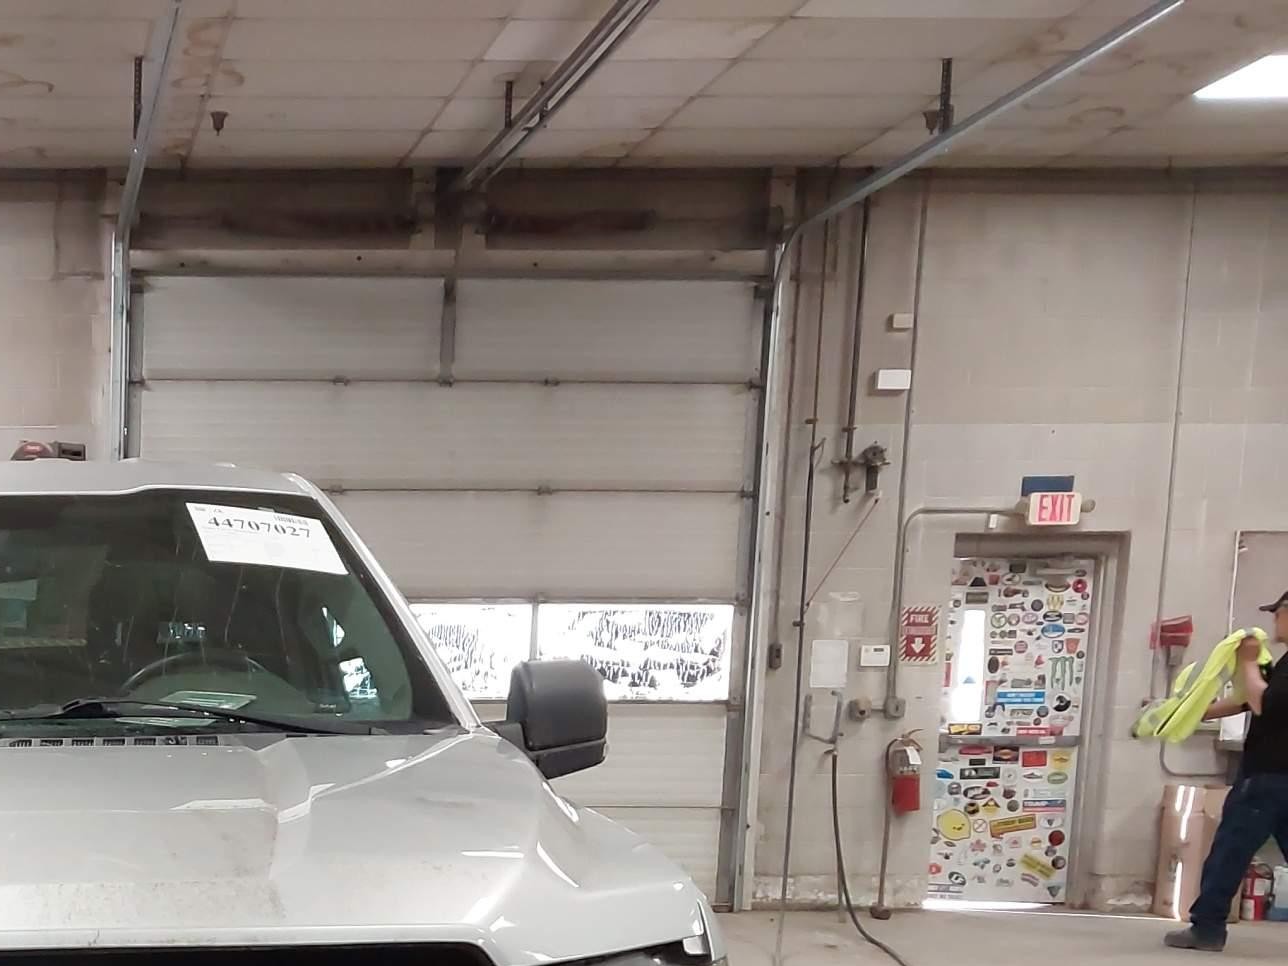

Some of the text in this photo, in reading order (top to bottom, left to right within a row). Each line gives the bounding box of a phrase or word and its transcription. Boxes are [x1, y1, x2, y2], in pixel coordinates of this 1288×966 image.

[1038, 494, 1075, 522] EXIT
[208, 516, 310, 538] 44707027
[909, 614, 929, 623] FIRE
